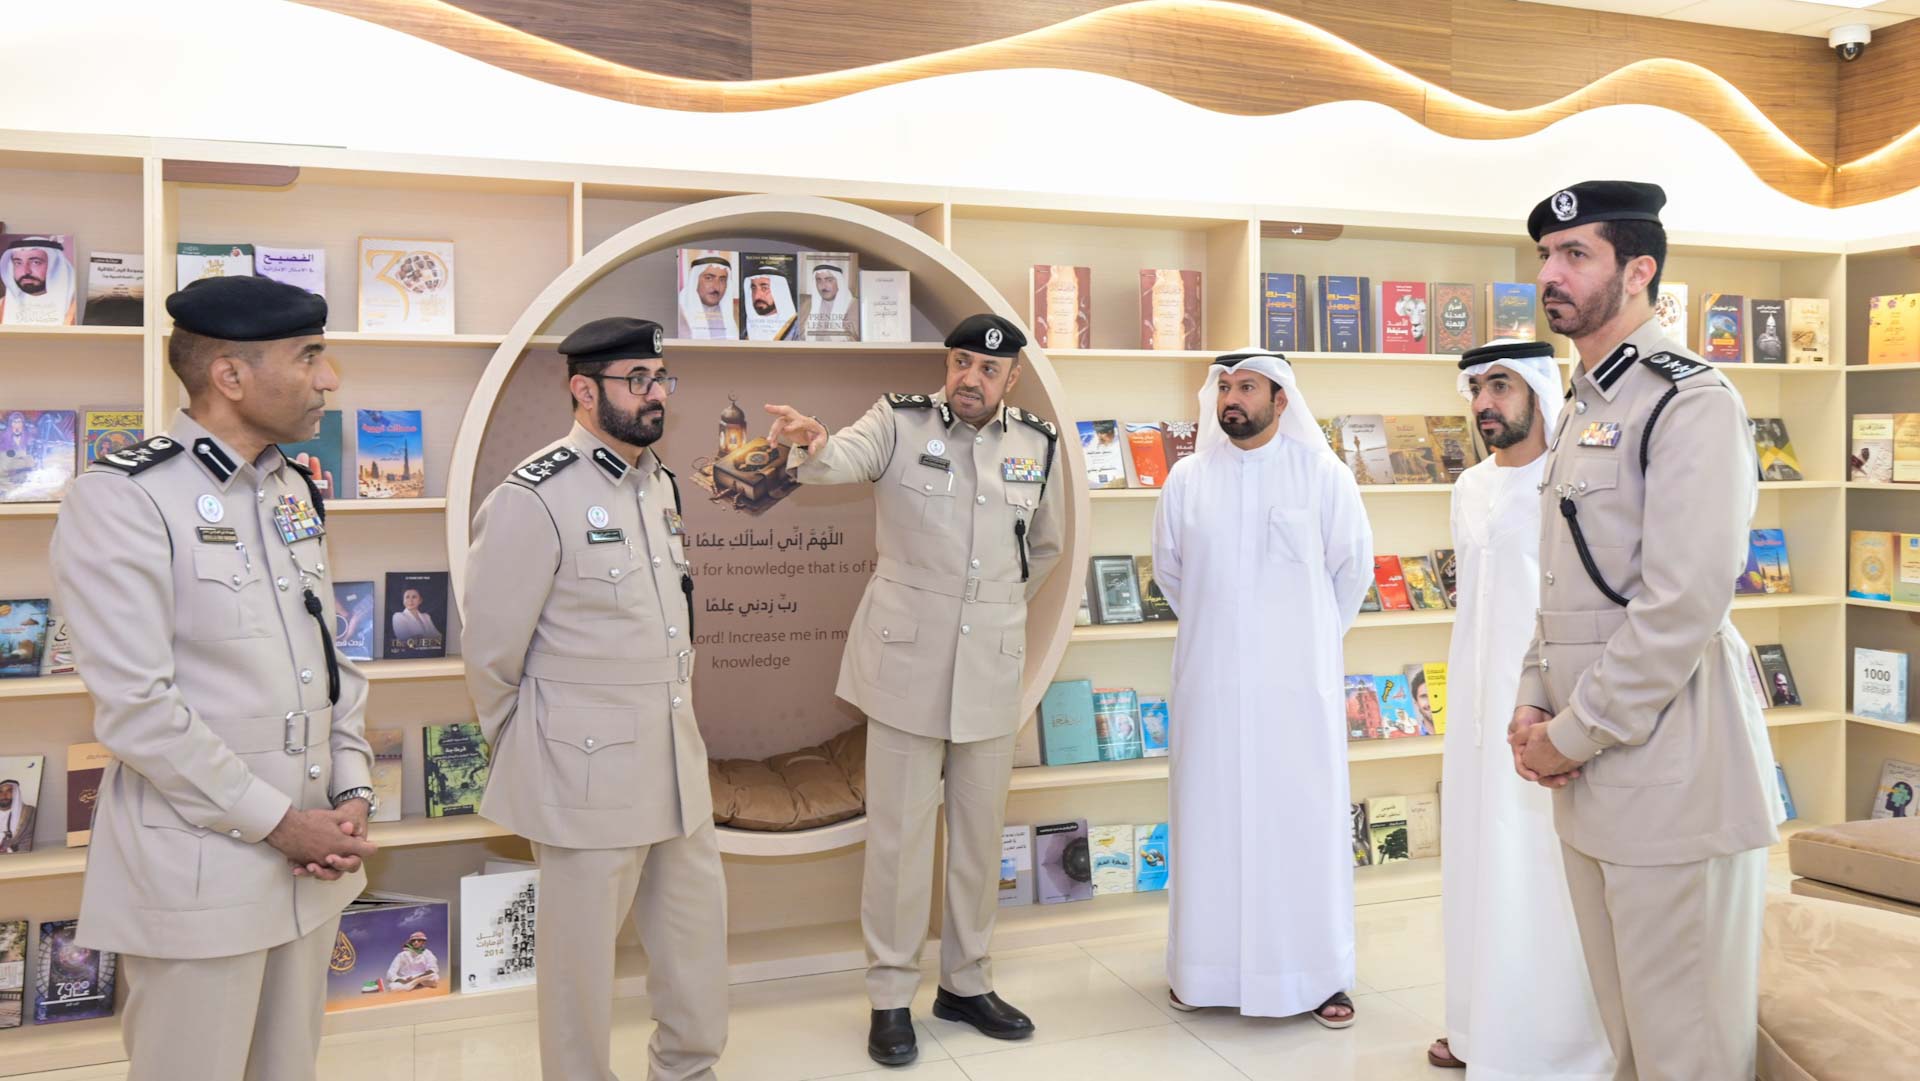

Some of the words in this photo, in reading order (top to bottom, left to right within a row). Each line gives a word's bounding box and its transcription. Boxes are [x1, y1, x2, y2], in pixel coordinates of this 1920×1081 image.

[263, 253, 314, 265] الفصيح
[704, 562, 723, 576] for
[727, 561, 805, 577] knowledge
[808, 560, 835, 575] that
[839, 560, 849, 574] is
[852, 559, 868, 574] of
[407, 638, 442, 649] QUEEN
[728, 630, 786, 644] Increase
[790, 629, 811, 642] me
[815, 628, 827, 641] in
[712, 653, 790, 670] knowledge
[1863, 667, 1891, 682] 1000
[484, 947, 504, 958] 2014
